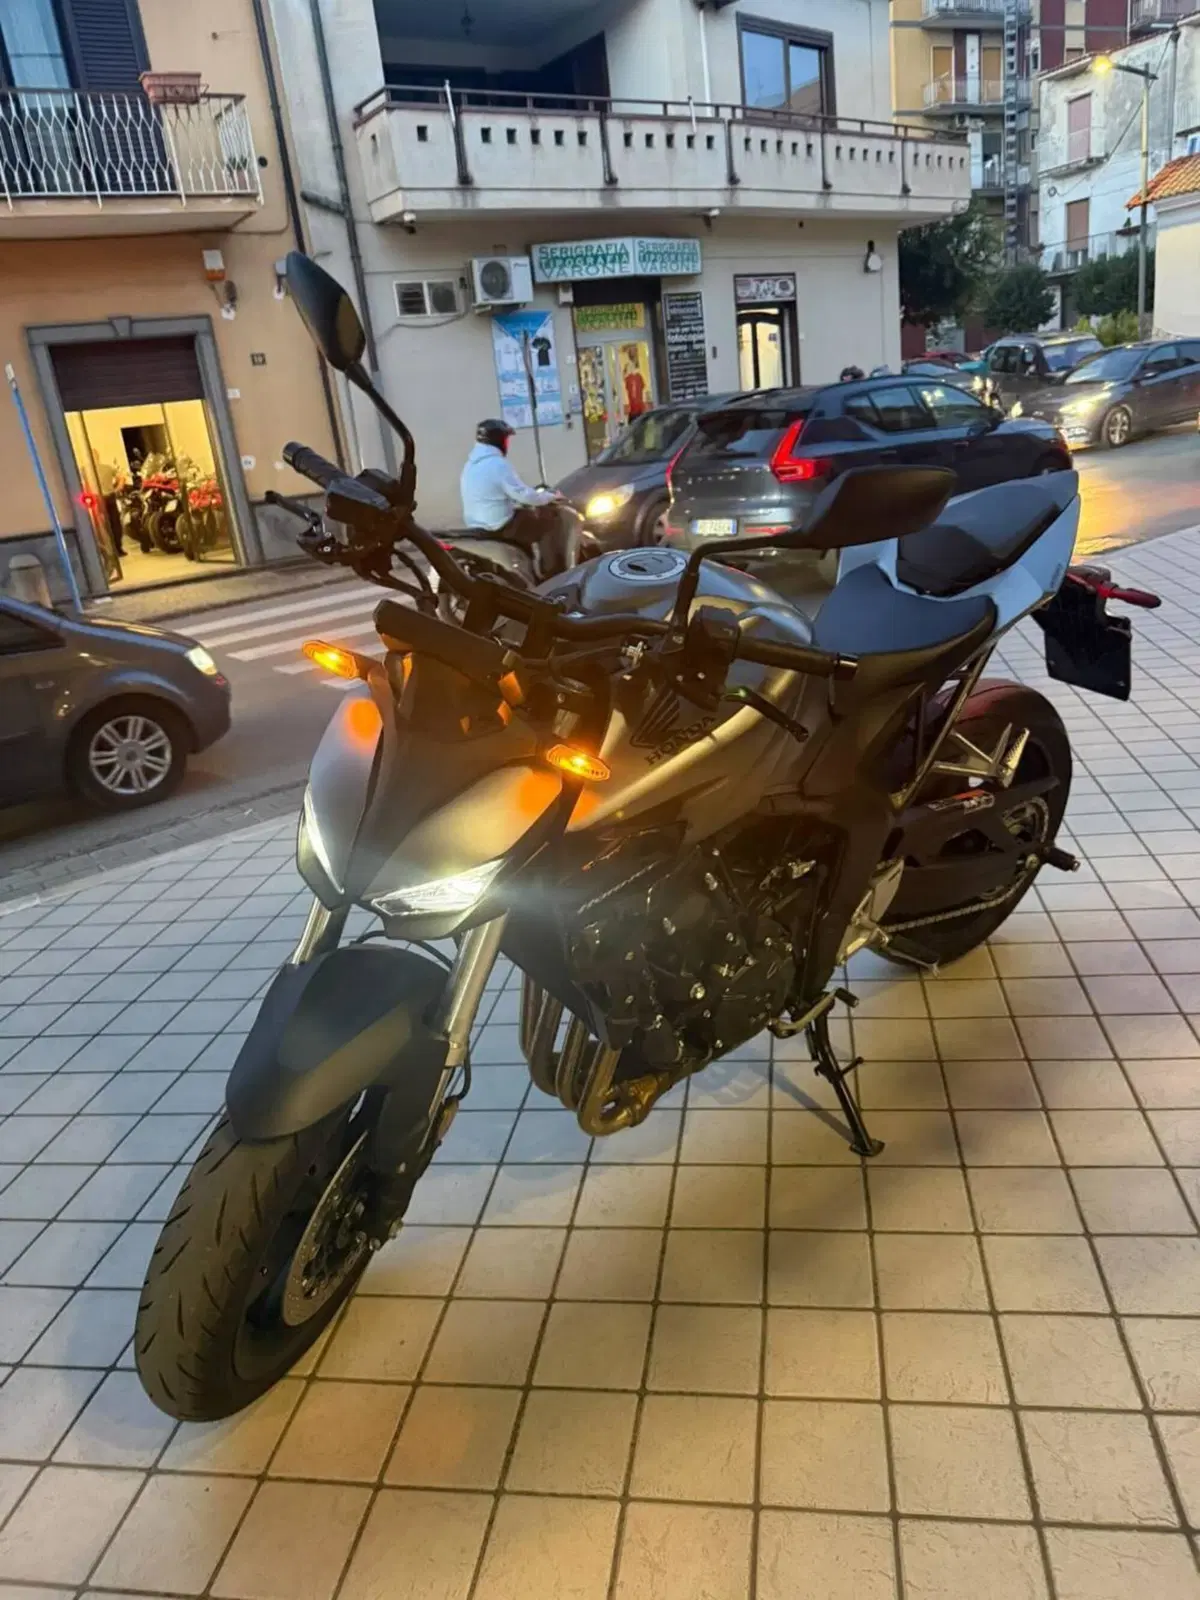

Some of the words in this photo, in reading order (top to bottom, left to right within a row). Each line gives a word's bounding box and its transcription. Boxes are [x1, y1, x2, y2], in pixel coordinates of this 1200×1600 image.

[538, 242, 628, 260] SERIGRAFIA
[541, 263, 630, 279] VARONE
[640, 261, 698, 273] VARONE
[644, 715, 716, 764] HONDA
